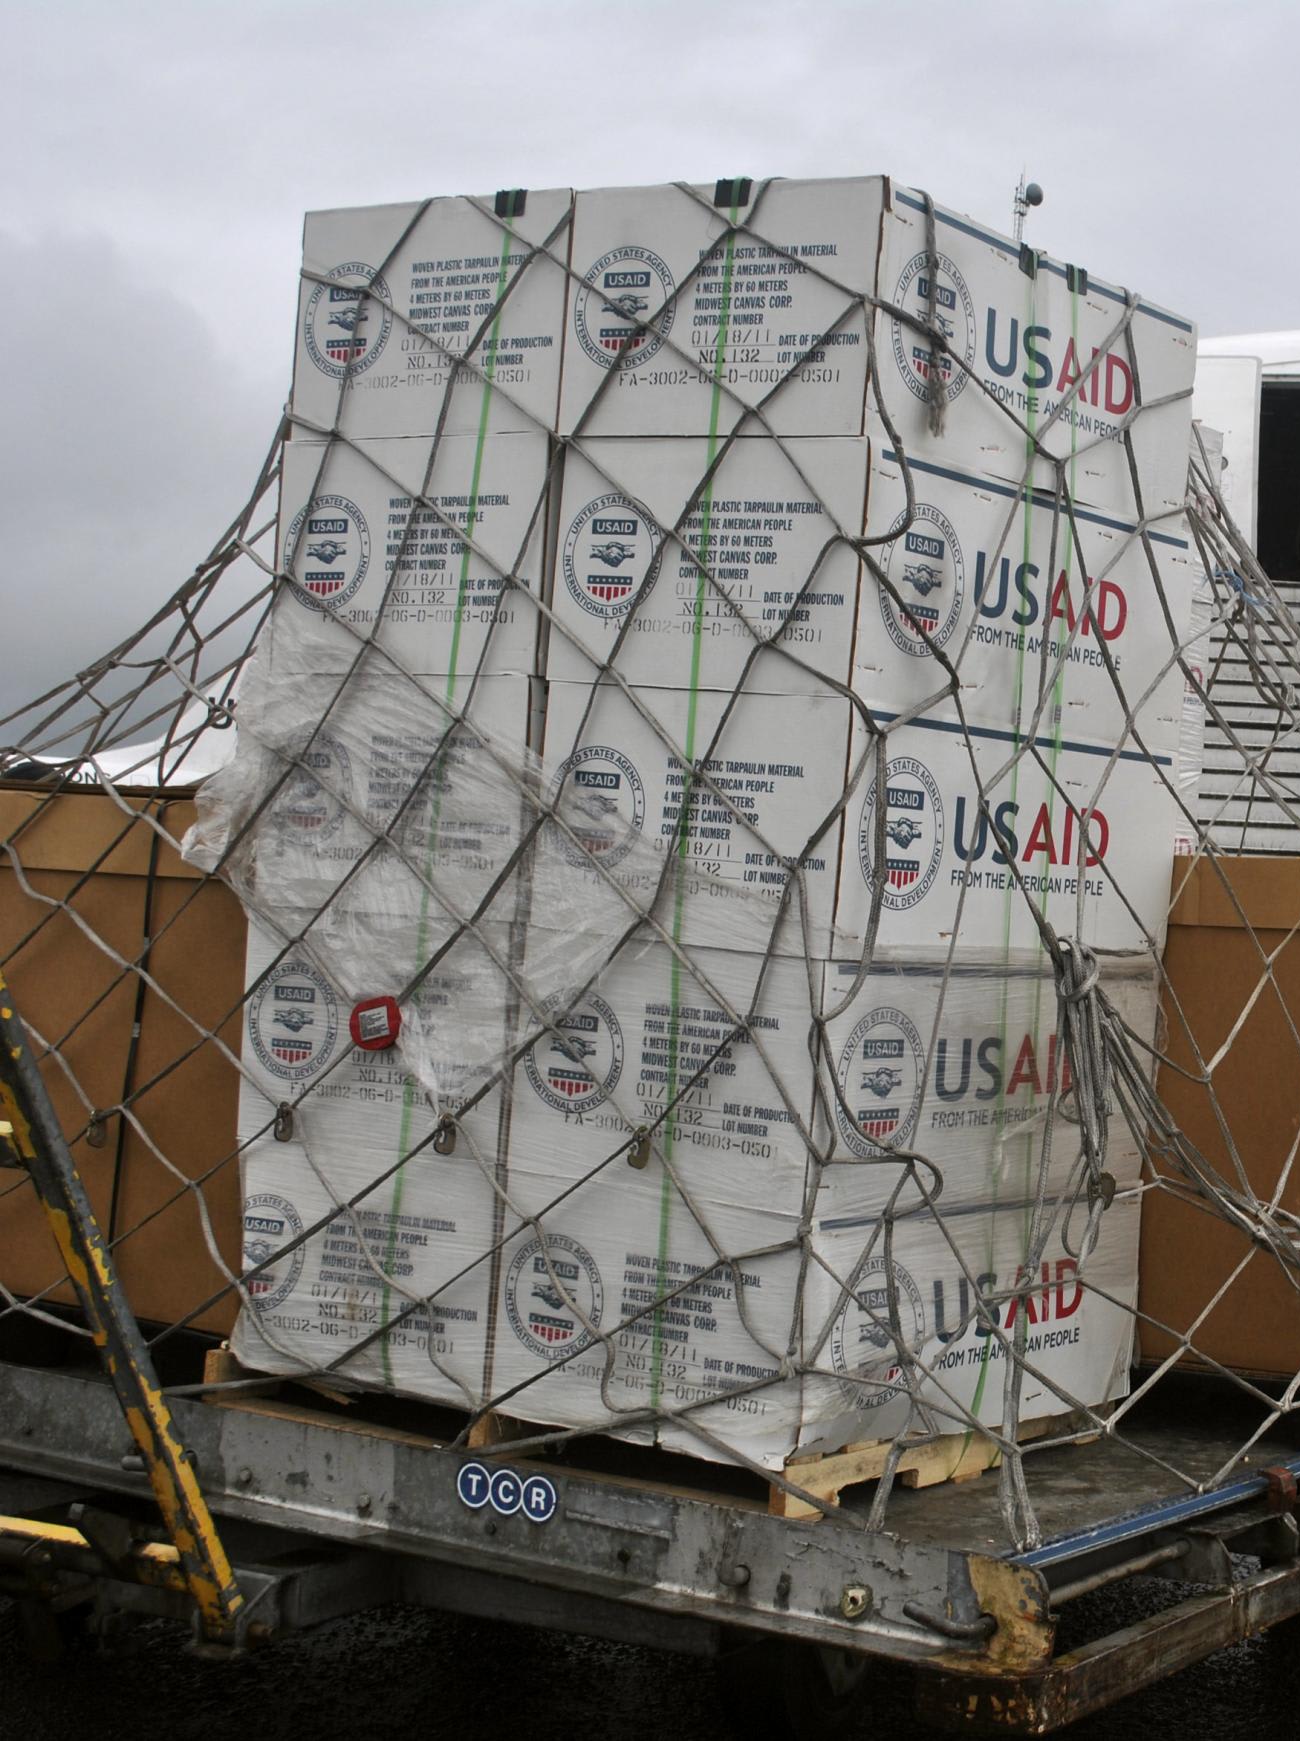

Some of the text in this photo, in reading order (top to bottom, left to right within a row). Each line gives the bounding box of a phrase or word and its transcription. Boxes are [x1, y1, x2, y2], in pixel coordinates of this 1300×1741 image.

[801, 245, 837, 256] MATERIAL
[337, 264, 364, 276] STATES
[412, 256, 499, 273] WOVEN PLASTIC TARPAULIN
[613, 249, 672, 287] STATES AGENCY
[737, 264, 775, 275] AMERICAN
[609, 274, 646, 285] USAID
[900, 257, 923, 291] UNITED
[411, 274, 480, 289] FROM THE AMERICAN
[734, 281, 788, 292] BY 60 METERS
[416, 289, 490, 304] METERS BY 60 METERS
[952, 270, 973, 318] AGENCY
[734, 297, 765, 309] CANVAS
[769, 296, 792, 308] CORP.
[409, 305, 471, 319] MIDWEST CANVAS
[733, 314, 763, 325] NUMBER
[442, 321, 469, 332] NUMBER
[501, 336, 553, 349] OF PRODUCTION
[779, 335, 796, 346] DATE
[800, 335, 809, 345] OF
[496, 354, 523, 364] NUMBER
[777, 353, 792, 363] LOT
[986, 307, 1133, 414] USAID
[1017, 390, 1039, 413] THE
[478, 495, 510, 505] MATERIAL
[713, 501, 822, 514] PLASTIC TARPAULIN MATERIAL
[344, 503, 367, 533] AGENCY
[571, 502, 599, 535] UNITED
[707, 518, 792, 530] THE AMERICAN PEOPLE
[312, 521, 344, 531] USAID
[597, 522, 633, 532] USAID
[420, 529, 439, 539] BY 60
[913, 507, 962, 565] STATES AGENCY
[689, 535, 773, 547] METERS BY 60 METERS
[910, 535, 939, 554] USAID
[420, 544, 448, 555] CANVAS
[720, 552, 777, 564] CANVAS CORP.
[420, 560, 446, 570] NUMBER
[718, 569, 748, 580] NUMBER
[392, 592, 444, 603] NO.132
[764, 592, 794, 604] DATE OF
[974, 551, 1127, 641] USAID
[763, 609, 777, 620] LOT
[971, 625, 1024, 651] FROM THE
[584, 749, 641, 791] STATES AGENCY
[726, 762, 804, 777] TARPAULIN MATERIAL
[580, 774, 616, 786] USAID
[746, 780, 774, 792] PEOPLE
[893, 760, 941, 813] STATES AGENCY
[665, 792, 710, 805] 4 BY
[889, 792, 919, 807] USAID
[702, 810, 732, 824] CANVAS
[700, 827, 730, 840] NUMBER
[954, 796, 1109, 867] USAID
[746, 853, 763, 864] DATE
[744, 870, 757, 881] LOT
[951, 870, 1005, 889] FROM THE
[280, 988, 311, 999] USAID
[592, 1000, 620, 1035] AGENCY
[644, 1020, 720, 1040] FROM AMERICAN
[843, 1010, 922, 1062] UNITED STATES AGENCY
[680, 1041, 700, 1054] BY 60
[867, 1043, 898, 1055] USAID
[714, 1063, 736, 1076] CORP.
[724, 1103, 751, 1117] DATE OF
[932, 1109, 988, 1128] FROM THE
[722, 1120, 768, 1137] LOT NUMBER
[246, 1221, 280, 1232] USAID
[401, 1232, 428, 1246] PEOPLE
[574, 1248, 600, 1284] AGENCY
[703, 1285, 732, 1300] PEOPLE
[683, 1300, 712, 1314] METERS
[934, 1258, 1083, 1343] USAID
[694, 1317, 717, 1332] CORP.
[968, 1327, 1079, 1364] THE PEOPLE
[704, 1358, 734, 1373] DATE OF
[468, 1474, 546, 1510] TCR
